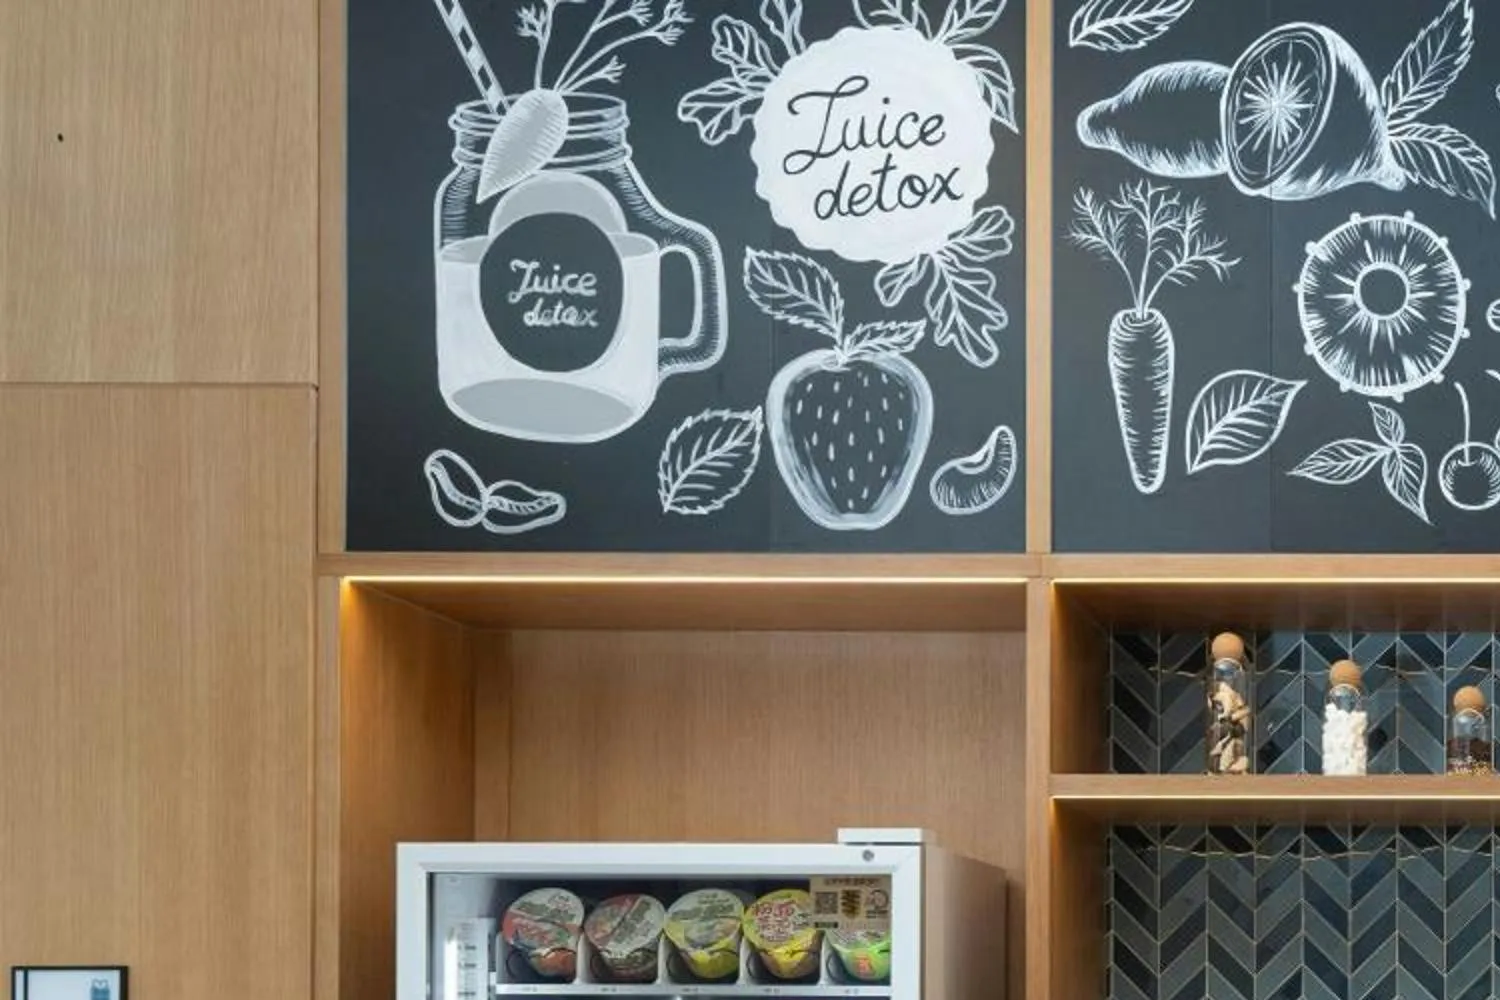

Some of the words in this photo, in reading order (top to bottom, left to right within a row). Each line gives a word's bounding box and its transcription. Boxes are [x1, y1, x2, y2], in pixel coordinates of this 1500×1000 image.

[784, 75, 946, 174] Juice
[814, 154, 964, 221] detox
[508, 259, 598, 303] Juice
[523, 298, 600, 328] detox
